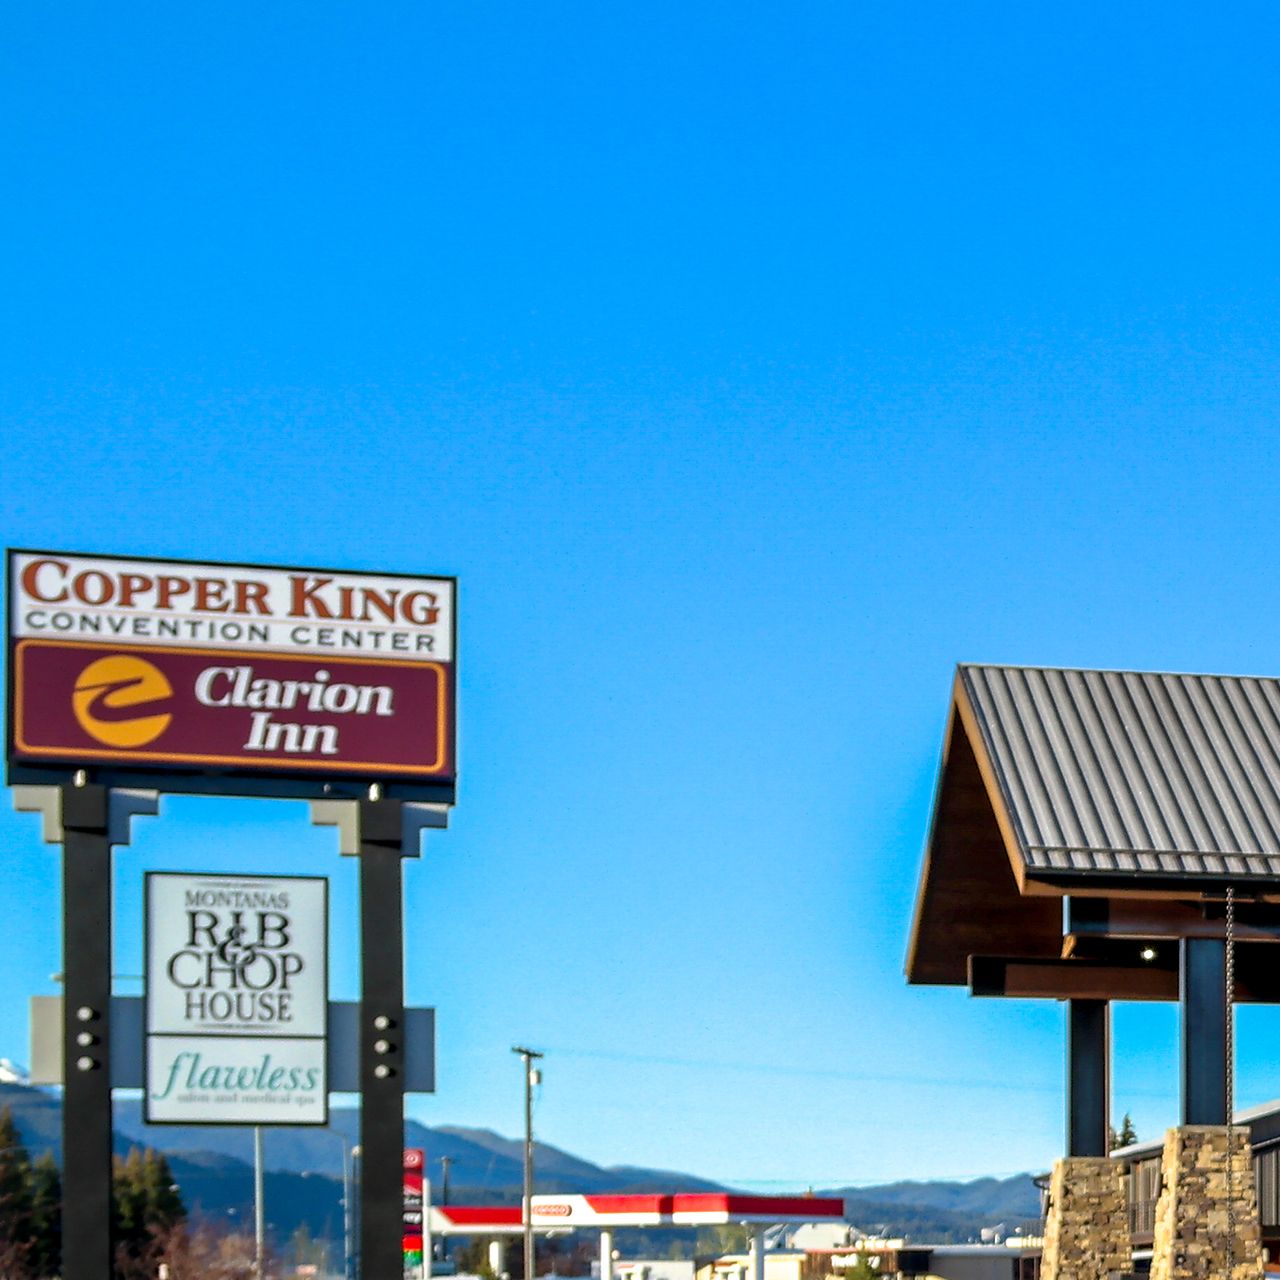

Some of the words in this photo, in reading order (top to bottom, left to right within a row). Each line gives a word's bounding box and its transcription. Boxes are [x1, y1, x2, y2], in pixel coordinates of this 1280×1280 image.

[21, 559, 272, 616] COPPER
[288, 574, 440, 626] KING
[25, 611, 270, 643] CONVENTION
[290, 625, 436, 652] CENTER
[194, 666, 394, 717] Clarion
[243, 711, 339, 755] Inn
[184, 889, 289, 909] MONTANAS
[185, 910, 290, 949] RIB
[167, 950, 303, 990] CHOP
[184, 991, 292, 1022] HOUSE
[152, 1051, 321, 1101] flawless
